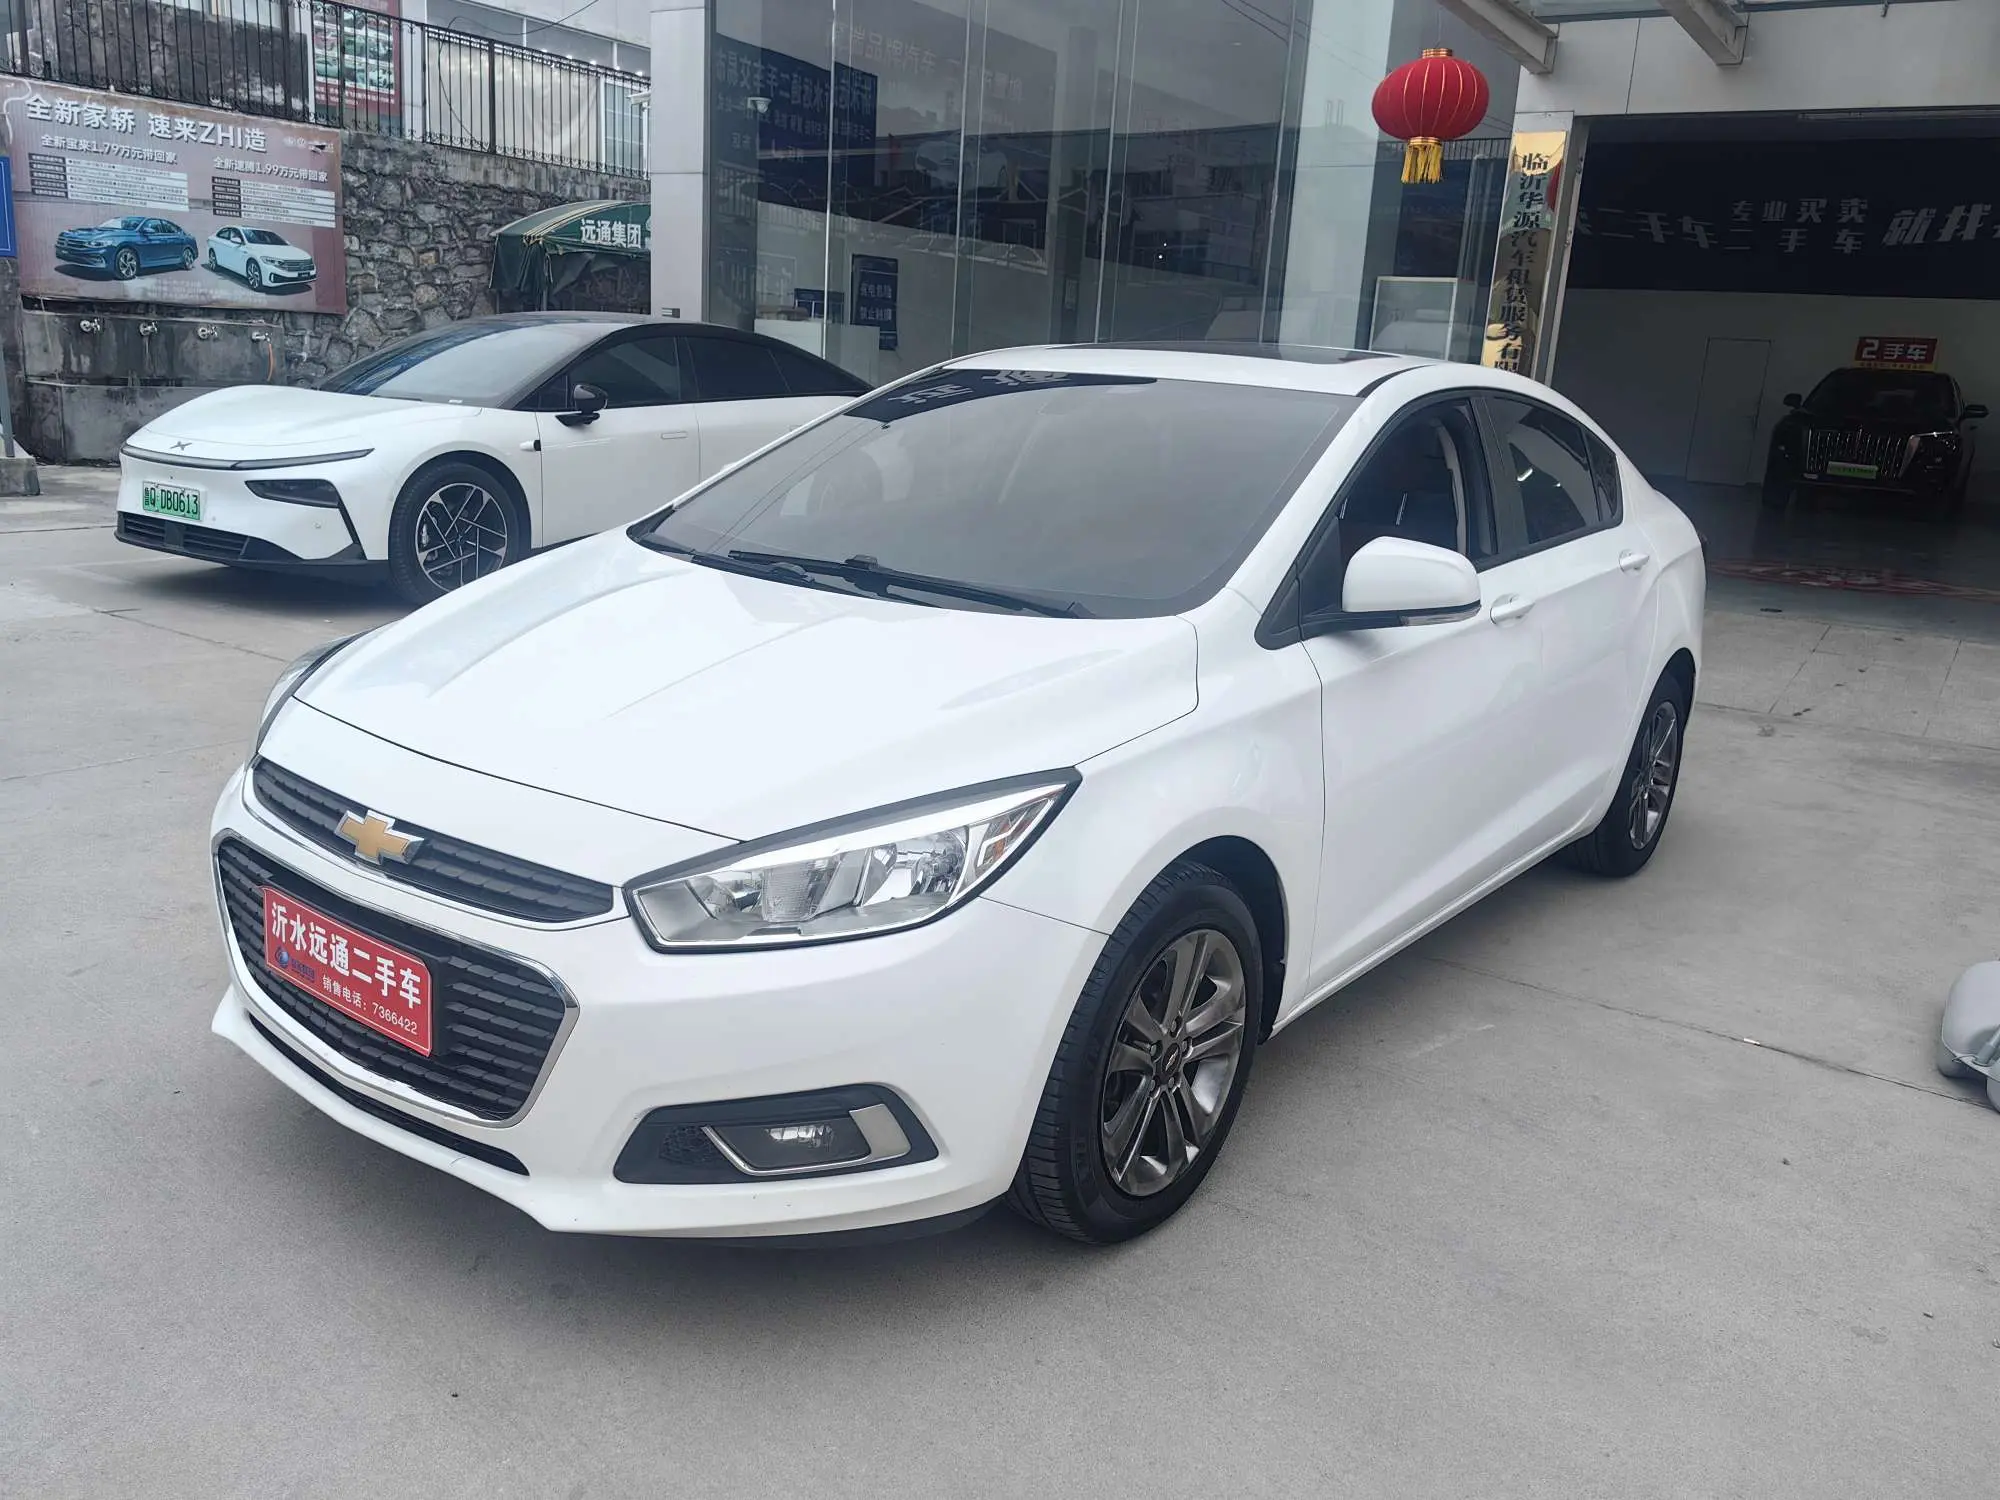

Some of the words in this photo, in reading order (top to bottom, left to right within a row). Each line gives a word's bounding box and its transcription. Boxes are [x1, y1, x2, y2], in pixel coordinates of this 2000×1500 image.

[26, 93, 136, 134] 全新家轿
[148, 113, 267, 152] 速来ZHI造
[40, 134, 178, 164] 全新宝来1.79万元带回家
[213, 156, 329, 183] 全新速腾1.99万元带回家
[1730, 197, 1869, 224] 专业买卖
[1881, 202, 2000, 247] 就找
[580, 218, 641, 249] 远通集团
[1723, 227, 1866, 255] 二手车
[1861, 338, 1928, 361] 2手车
[271, 902, 422, 1009] 沂水远通二手车
